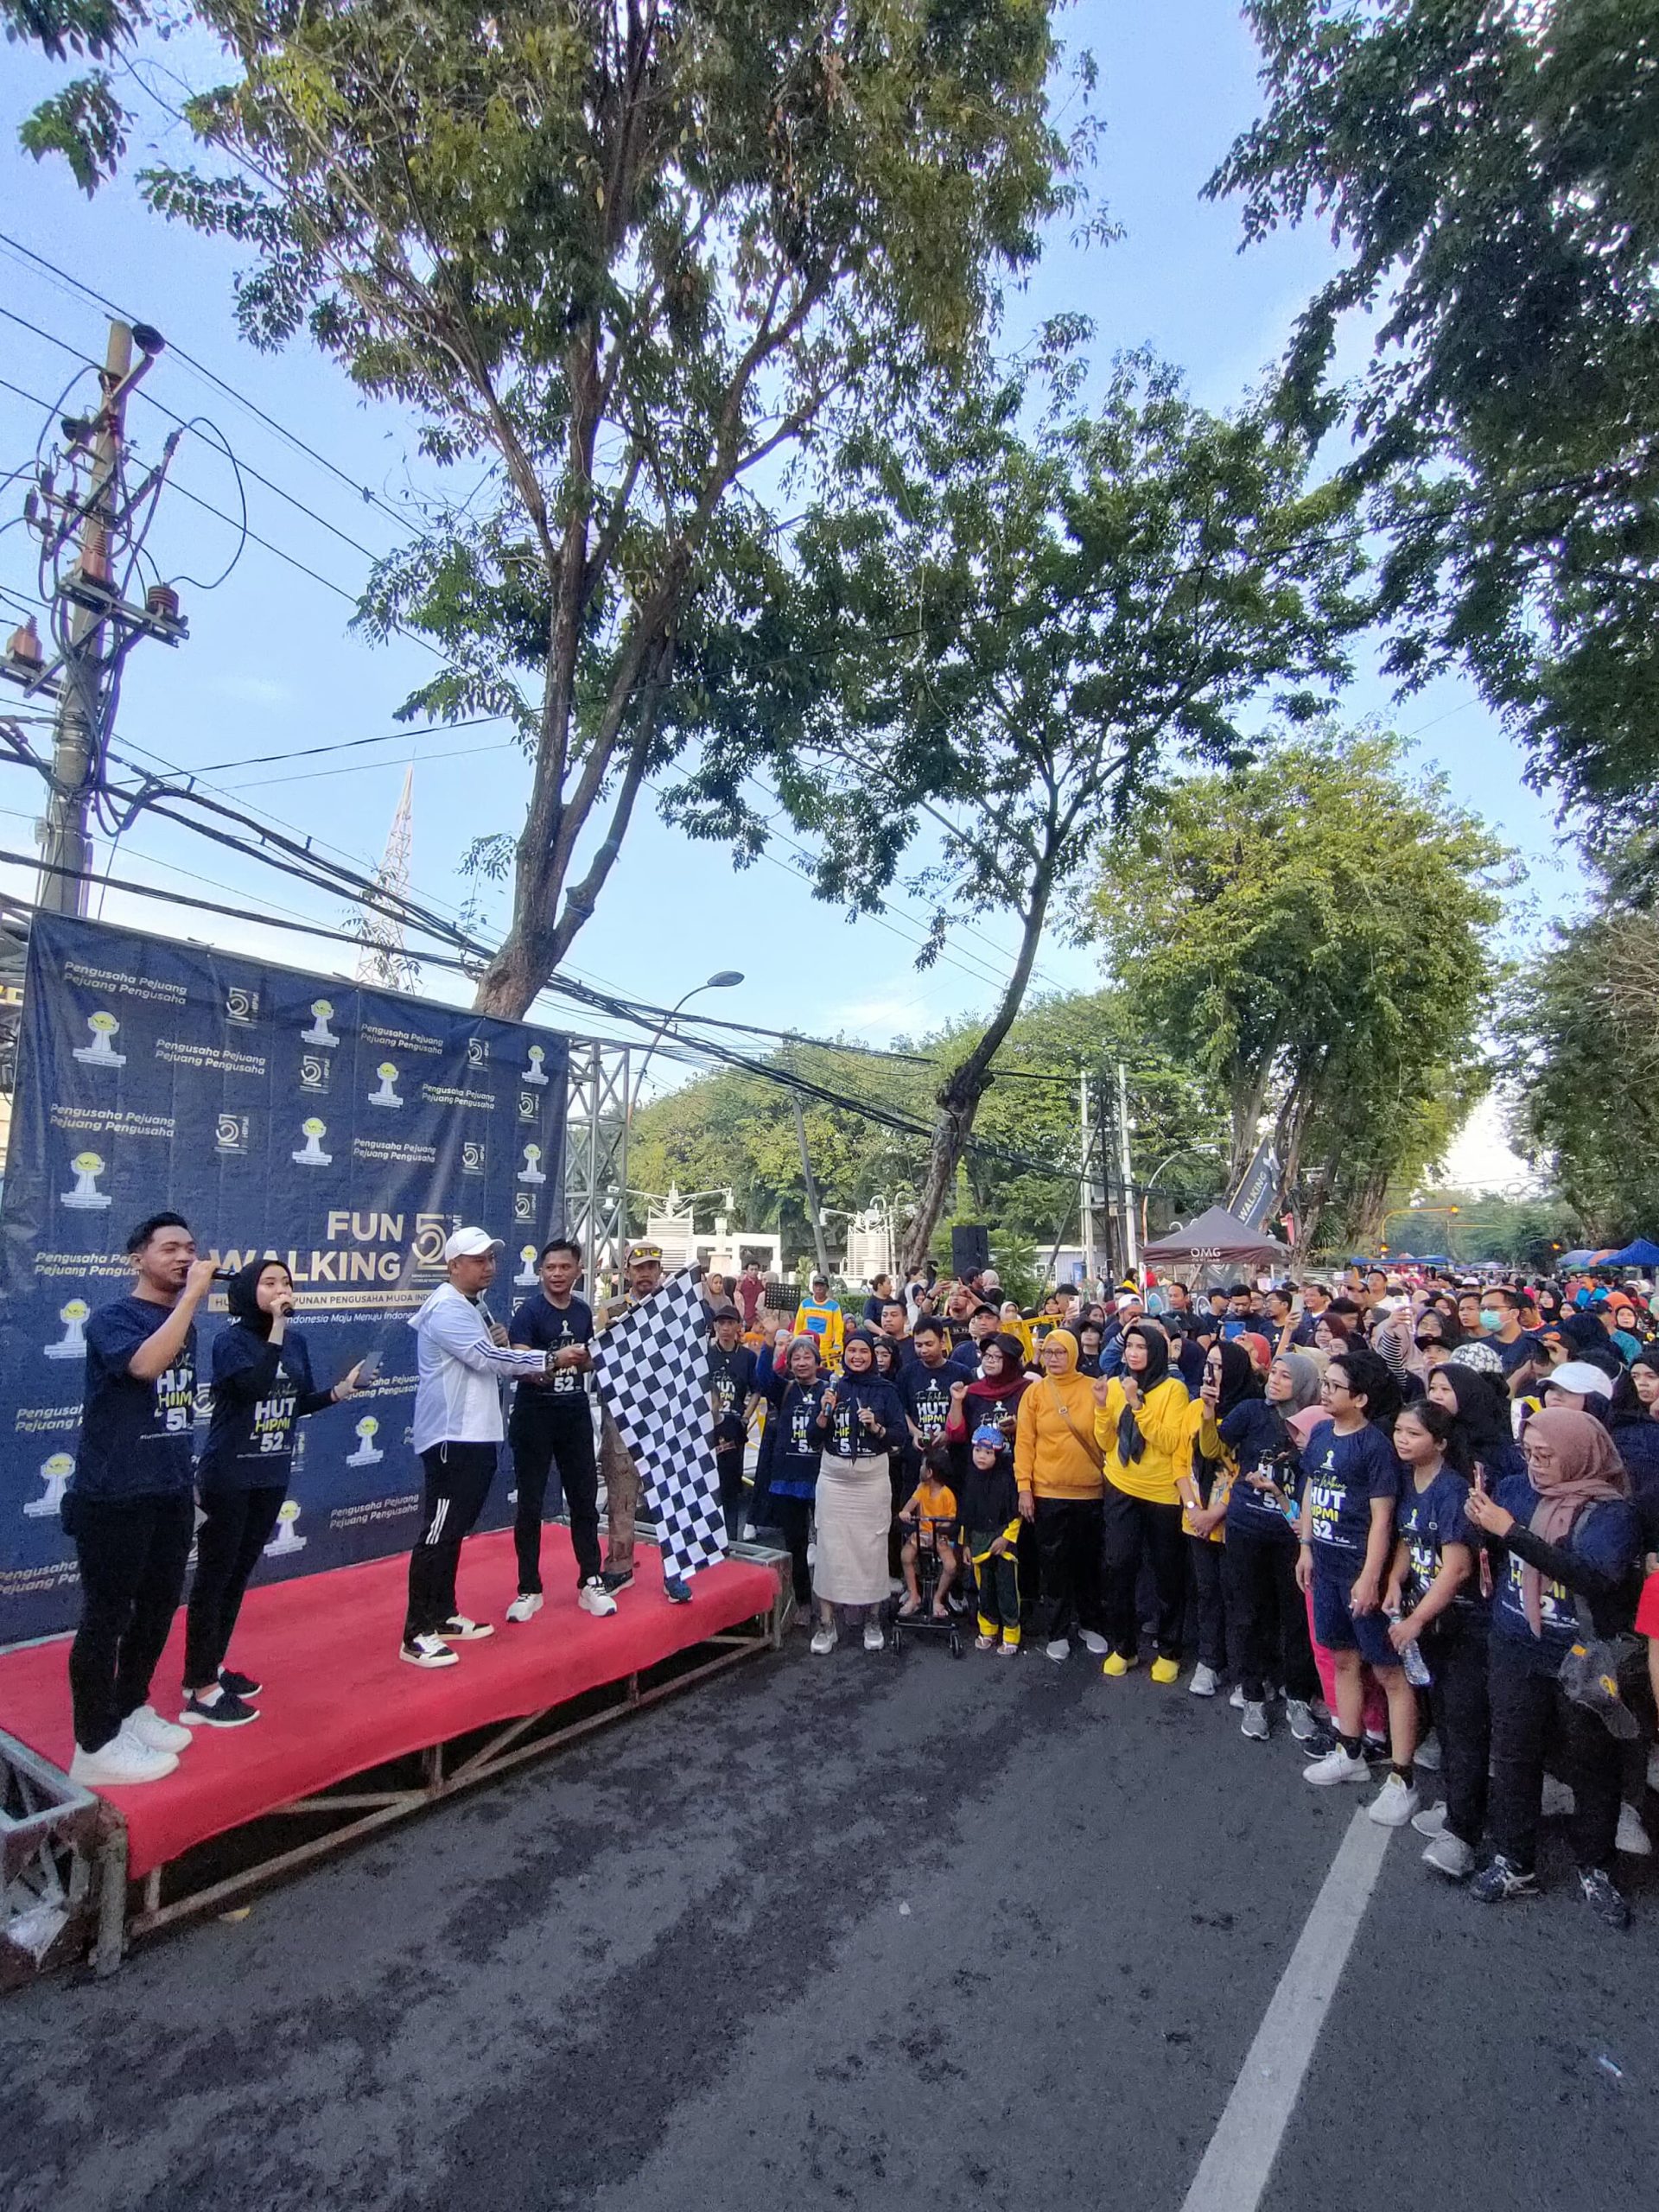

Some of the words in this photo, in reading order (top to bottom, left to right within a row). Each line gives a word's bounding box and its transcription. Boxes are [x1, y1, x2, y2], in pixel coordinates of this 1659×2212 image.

[63, 972, 117, 992] Pejuang
[118, 983, 187, 1005] Pengusaha
[64, 961, 137, 984] Pengusaha
[139, 977, 188, 995] Pejuang
[360, 1033, 397, 1047] Pejuang
[397, 1039, 442, 1055] Pengusaha
[361, 1023, 410, 1039] Pengusaha
[410, 1033, 444, 1047] Pejuang
[155, 1050, 203, 1066] Pejuang
[205, 1058, 265, 1075] Pengusaha
[156, 1039, 220, 1058] Pengusaha
[222, 1050, 266, 1065] Pejuang
[422, 1084, 464, 1096] Pengusaha
[466, 1090, 495, 1103] Pejuang
[422, 1092, 454, 1105] Pejuang
[454, 1096, 495, 1109] Pengusaha
[49, 1115, 102, 1131] Pejuang
[105, 1122, 175, 1137] Pengusaha
[50, 1103, 123, 1121] Pengusaha
[125, 1111, 176, 1128] Pejuang
[353, 1138, 402, 1151] Pengusaha
[404, 1143, 436, 1155] Pejuang
[353, 1147, 389, 1160] Pejuang
[391, 1151, 435, 1163] Pengusaha
[1238, 1171, 1268, 1221] WALKING
[327, 1211, 404, 1243] FUN
[35, 1252, 107, 1264] Pengusaha
[1190, 1247, 1221, 1258] OMG
[35, 1264, 86, 1277] Pejuang
[89, 1266, 140, 1277] Pengus
[329, 1295, 384, 1304] PENGUSAHA
[287, 1314, 328, 1324] ndonesia
[331, 1313, 353, 1323] Maju
[354, 1312, 382, 1322] Menuju
[554, 1376, 575, 1393] 52
[254, 1397, 296, 1421] HUT
[917, 1402, 950, 1415] HUT
[919, 1414, 945, 1423] HIPMI
[15, 1419, 74, 1433] Pejuang
[255, 1417, 291, 1433] HIPMI
[260, 1431, 284, 1452] 52
[329, 1514, 368, 1529] Pejuang
[370, 1503, 419, 1520] Pengusaha
[330, 1501, 382, 1518] Pengusaha
[384, 1494, 419, 1508] Pejuang
[1313, 1517, 1333, 1540] 52
